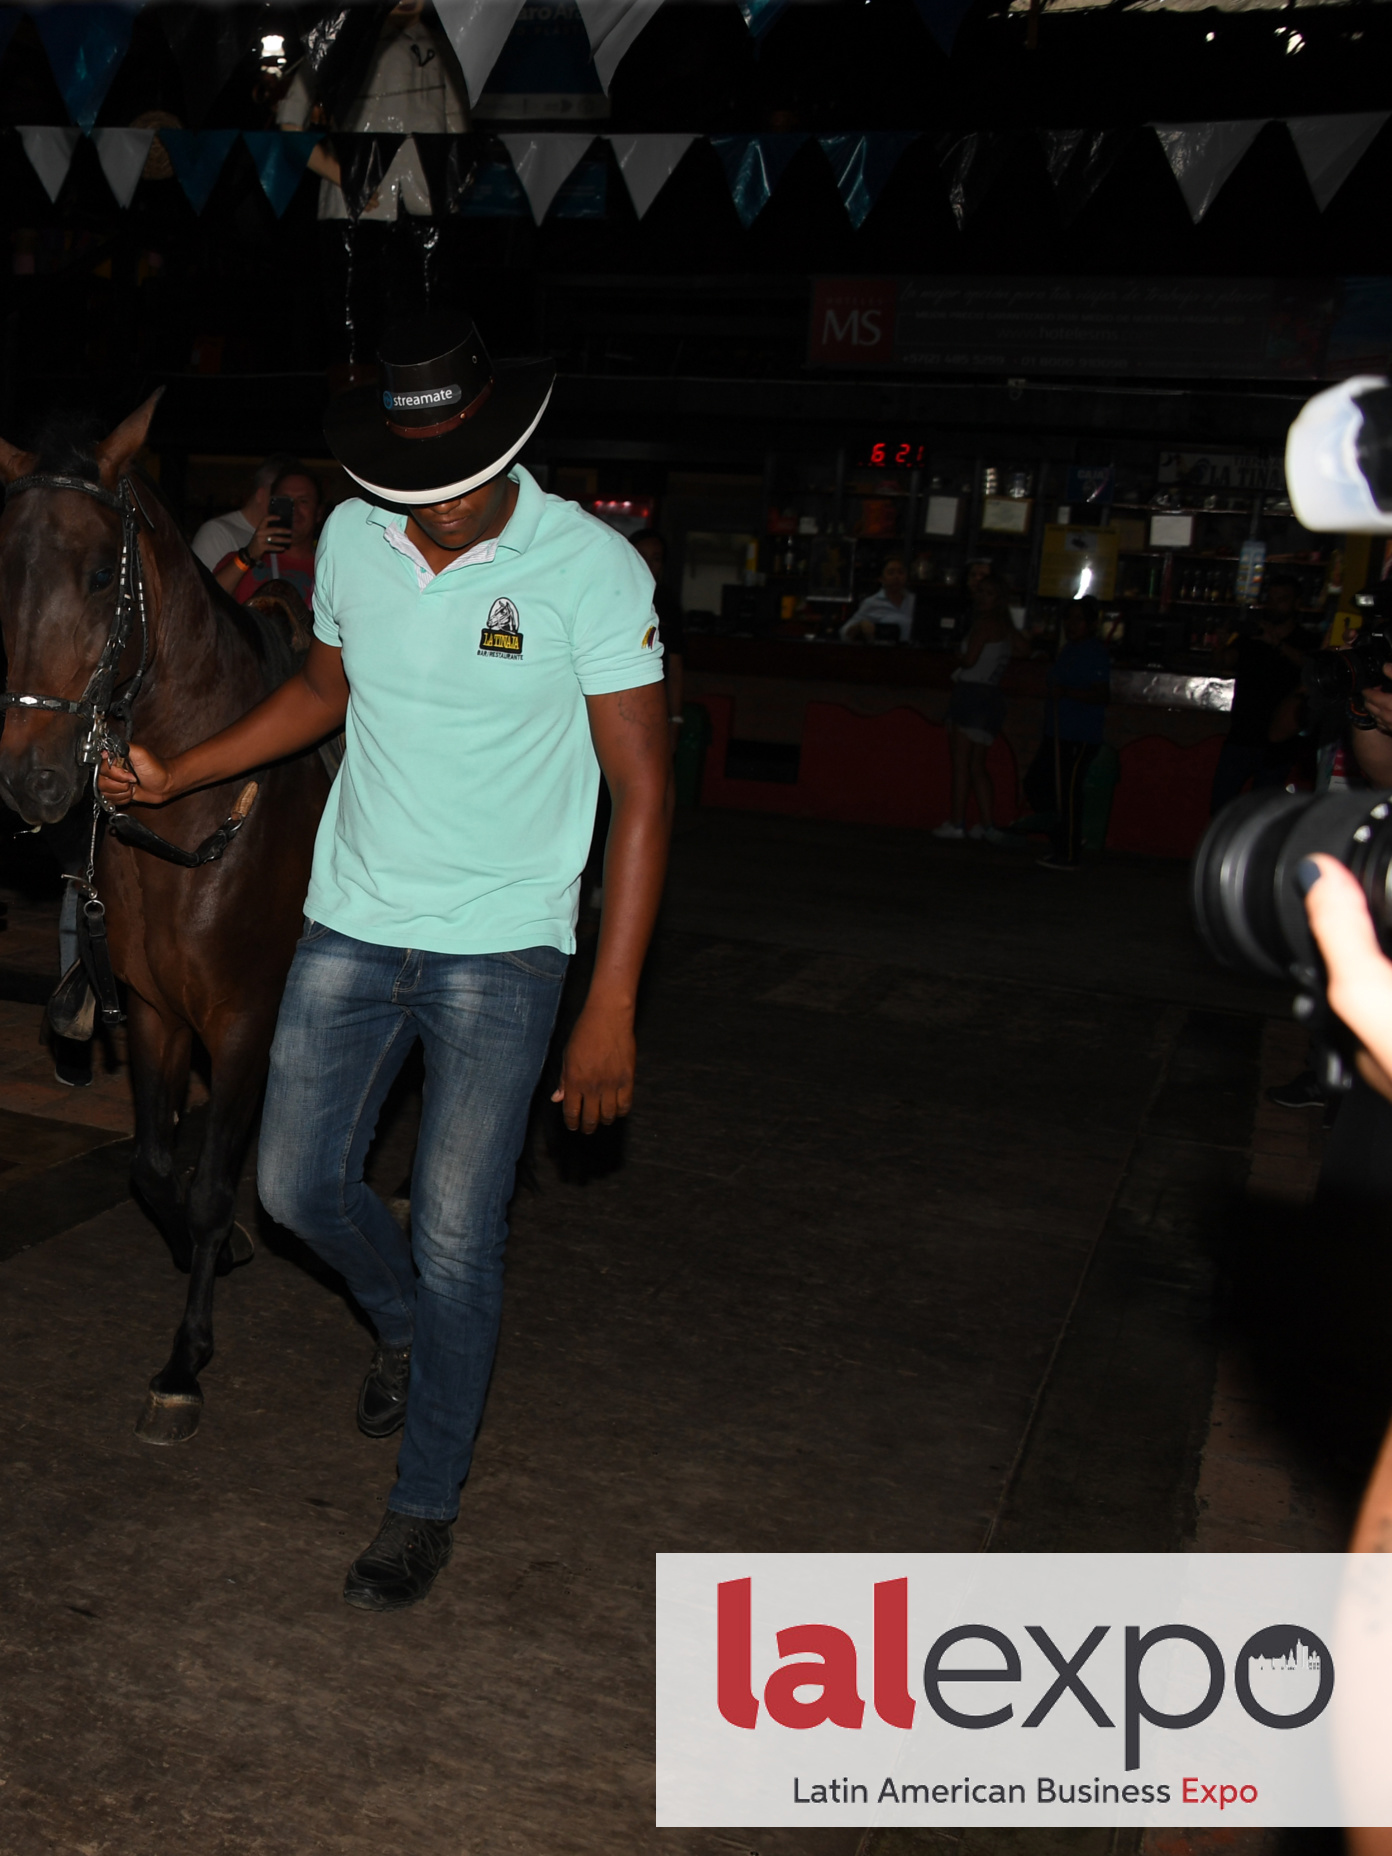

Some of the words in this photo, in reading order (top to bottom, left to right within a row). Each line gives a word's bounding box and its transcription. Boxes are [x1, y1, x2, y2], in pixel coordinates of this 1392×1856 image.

[822, 309, 883, 346] MS
[394, 389, 452, 407] streamate
[483, 632, 494, 646] LA
[494, 634, 520, 649] TINAJA
